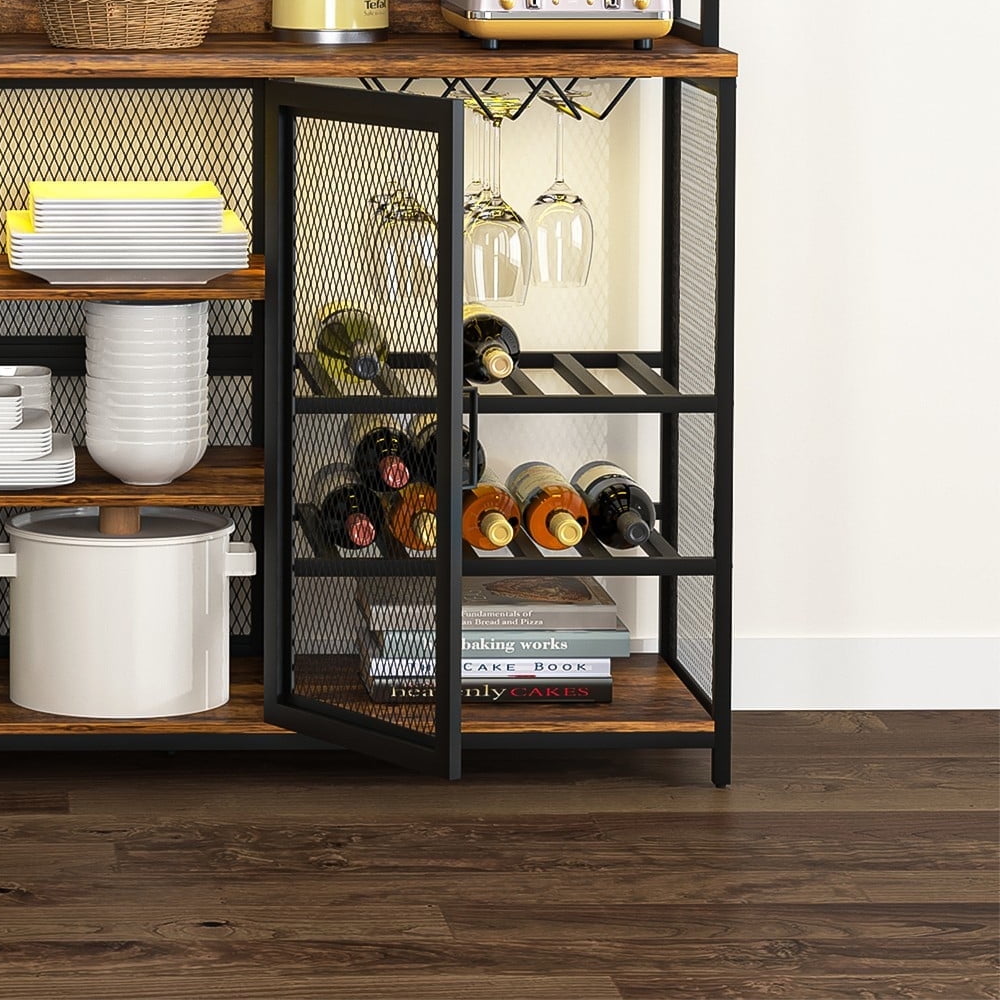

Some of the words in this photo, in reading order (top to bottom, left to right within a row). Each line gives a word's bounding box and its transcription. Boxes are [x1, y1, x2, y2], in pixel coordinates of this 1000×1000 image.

[363, 0, 386, 10] Tefal
[462, 638, 515, 653] baking
[519, 638, 568, 650] works
[463, 662, 516, 671] CAKE
[534, 662, 586, 671] BOOK
[510, 686, 590, 697] CAKES
